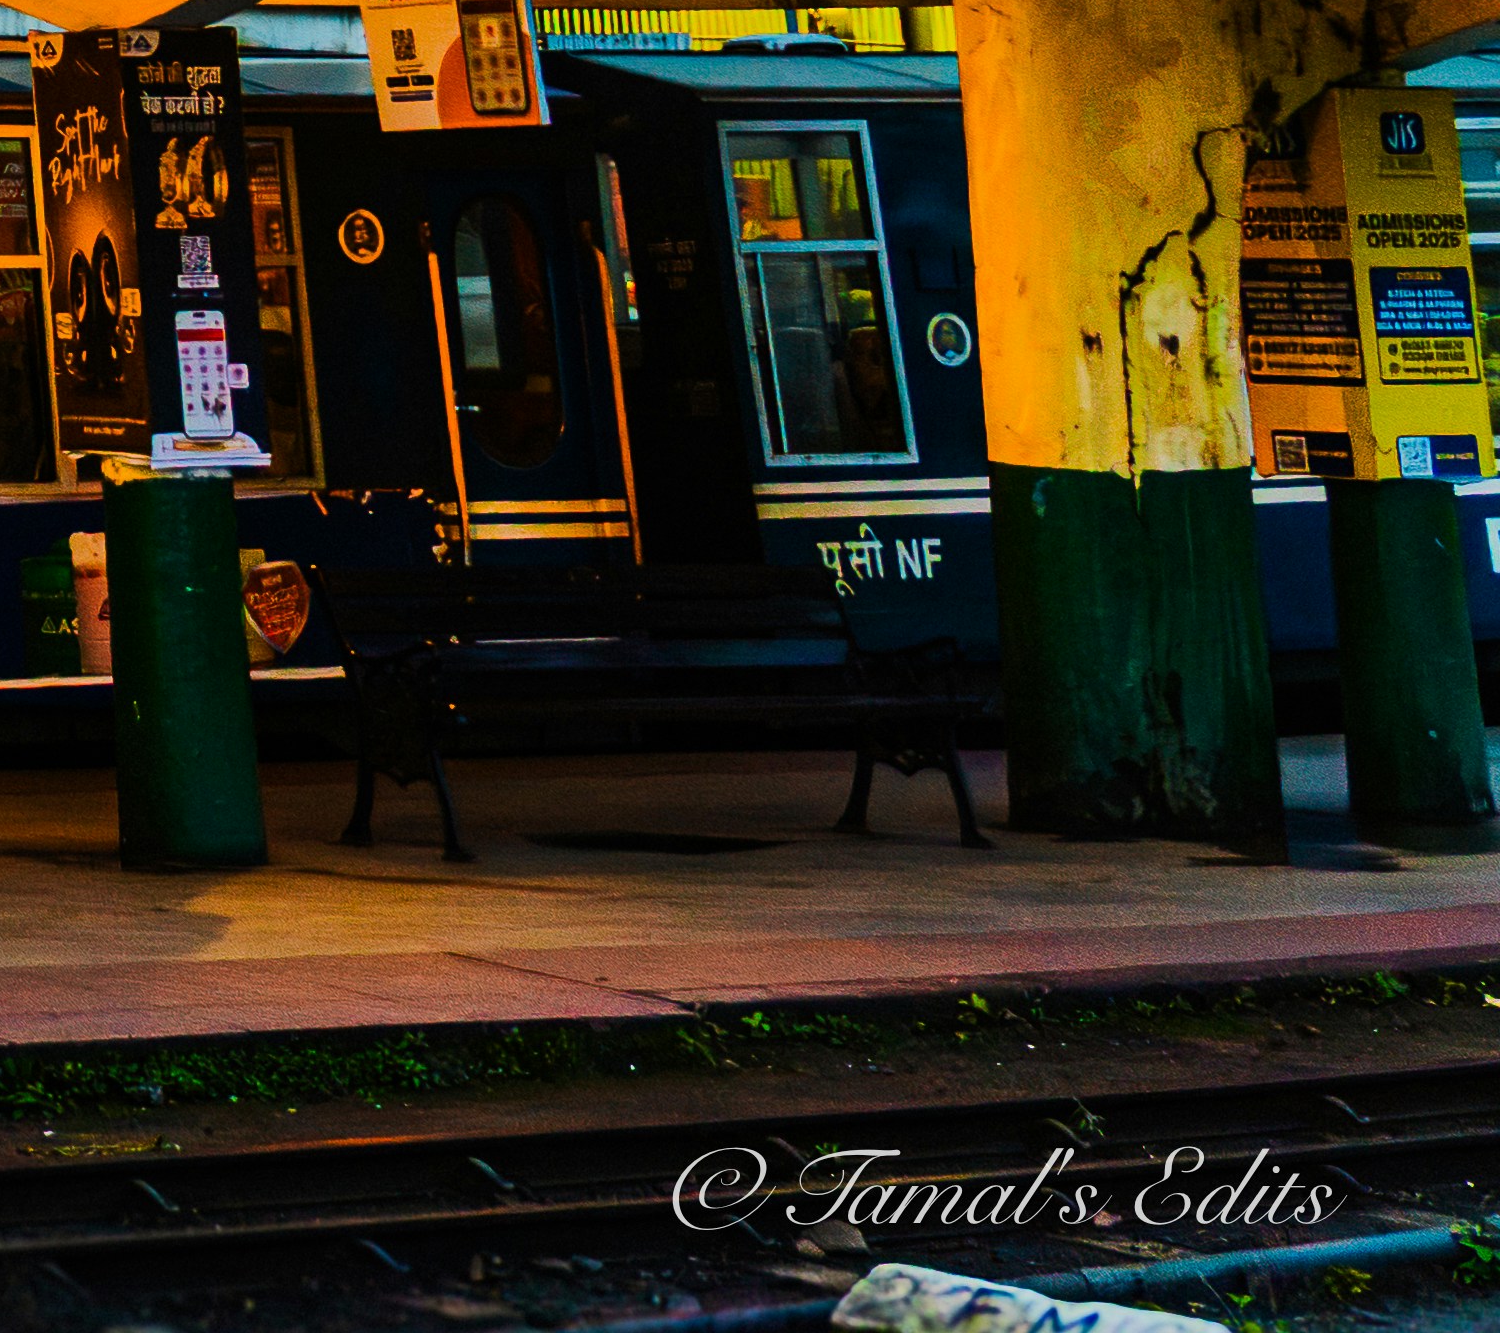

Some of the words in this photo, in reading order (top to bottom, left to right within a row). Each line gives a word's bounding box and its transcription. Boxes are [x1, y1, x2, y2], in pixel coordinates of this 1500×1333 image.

[1244, 206, 1348, 223] DMISSIONS
[1358, 213, 1466, 230] ADMISSIONS
[1243, 224, 1291, 241] OPEN
[1367, 231, 1415, 248] OPEN
[816, 522, 885, 597] पूसी
[896, 538, 942, 581] NF
